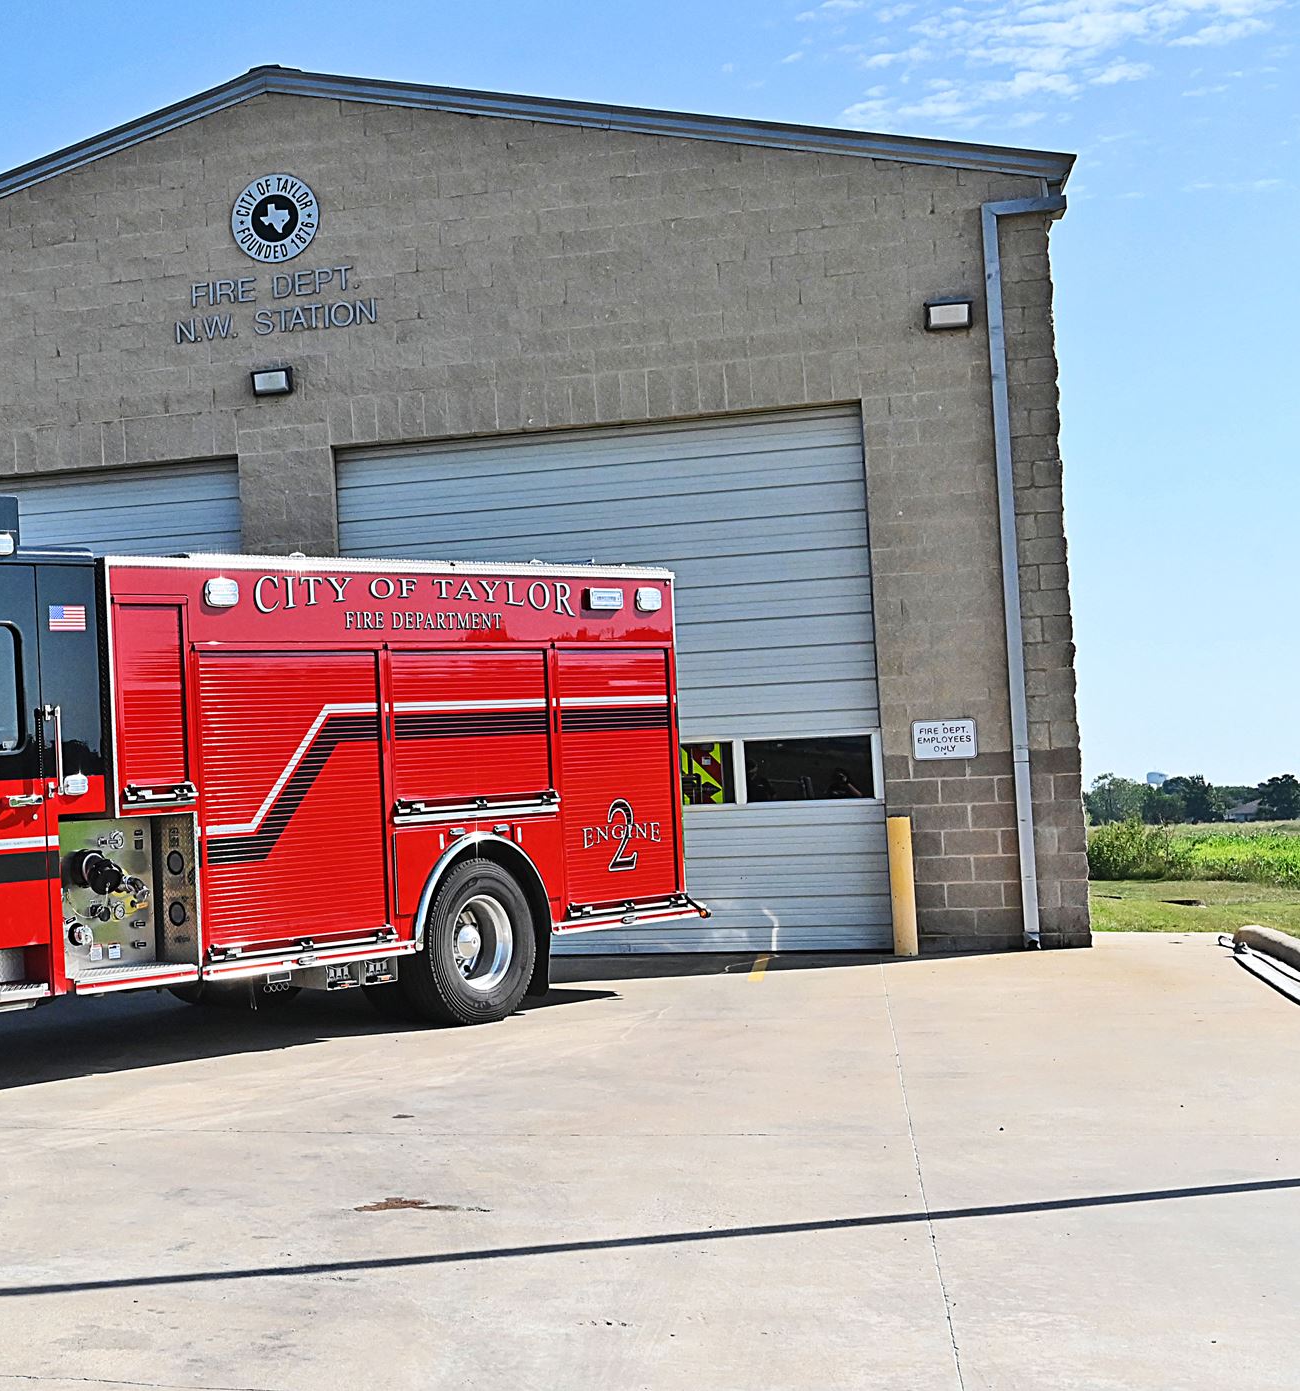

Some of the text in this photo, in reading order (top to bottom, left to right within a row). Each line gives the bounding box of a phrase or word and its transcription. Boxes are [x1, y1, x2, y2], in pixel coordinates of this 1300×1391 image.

[236, 177, 313, 217] CITY OF TAYLOR
[236, 221, 315, 259] FOUNDED 1876
[190, 265, 360, 307] FIRE DEPT.
[175, 298, 377, 344] N.W. STATION
[253, 575, 577, 617] CITY OF TAYLOR
[344, 611, 502, 631] FIRE DEPARTMENT
[917, 735, 972, 744] EMPLOYEES
[919, 726, 969, 735] FIRE DEPT.
[933, 745, 956, 753] ONLY
[582, 822, 661, 848] ENGINE
[607, 798, 638, 872] 2
